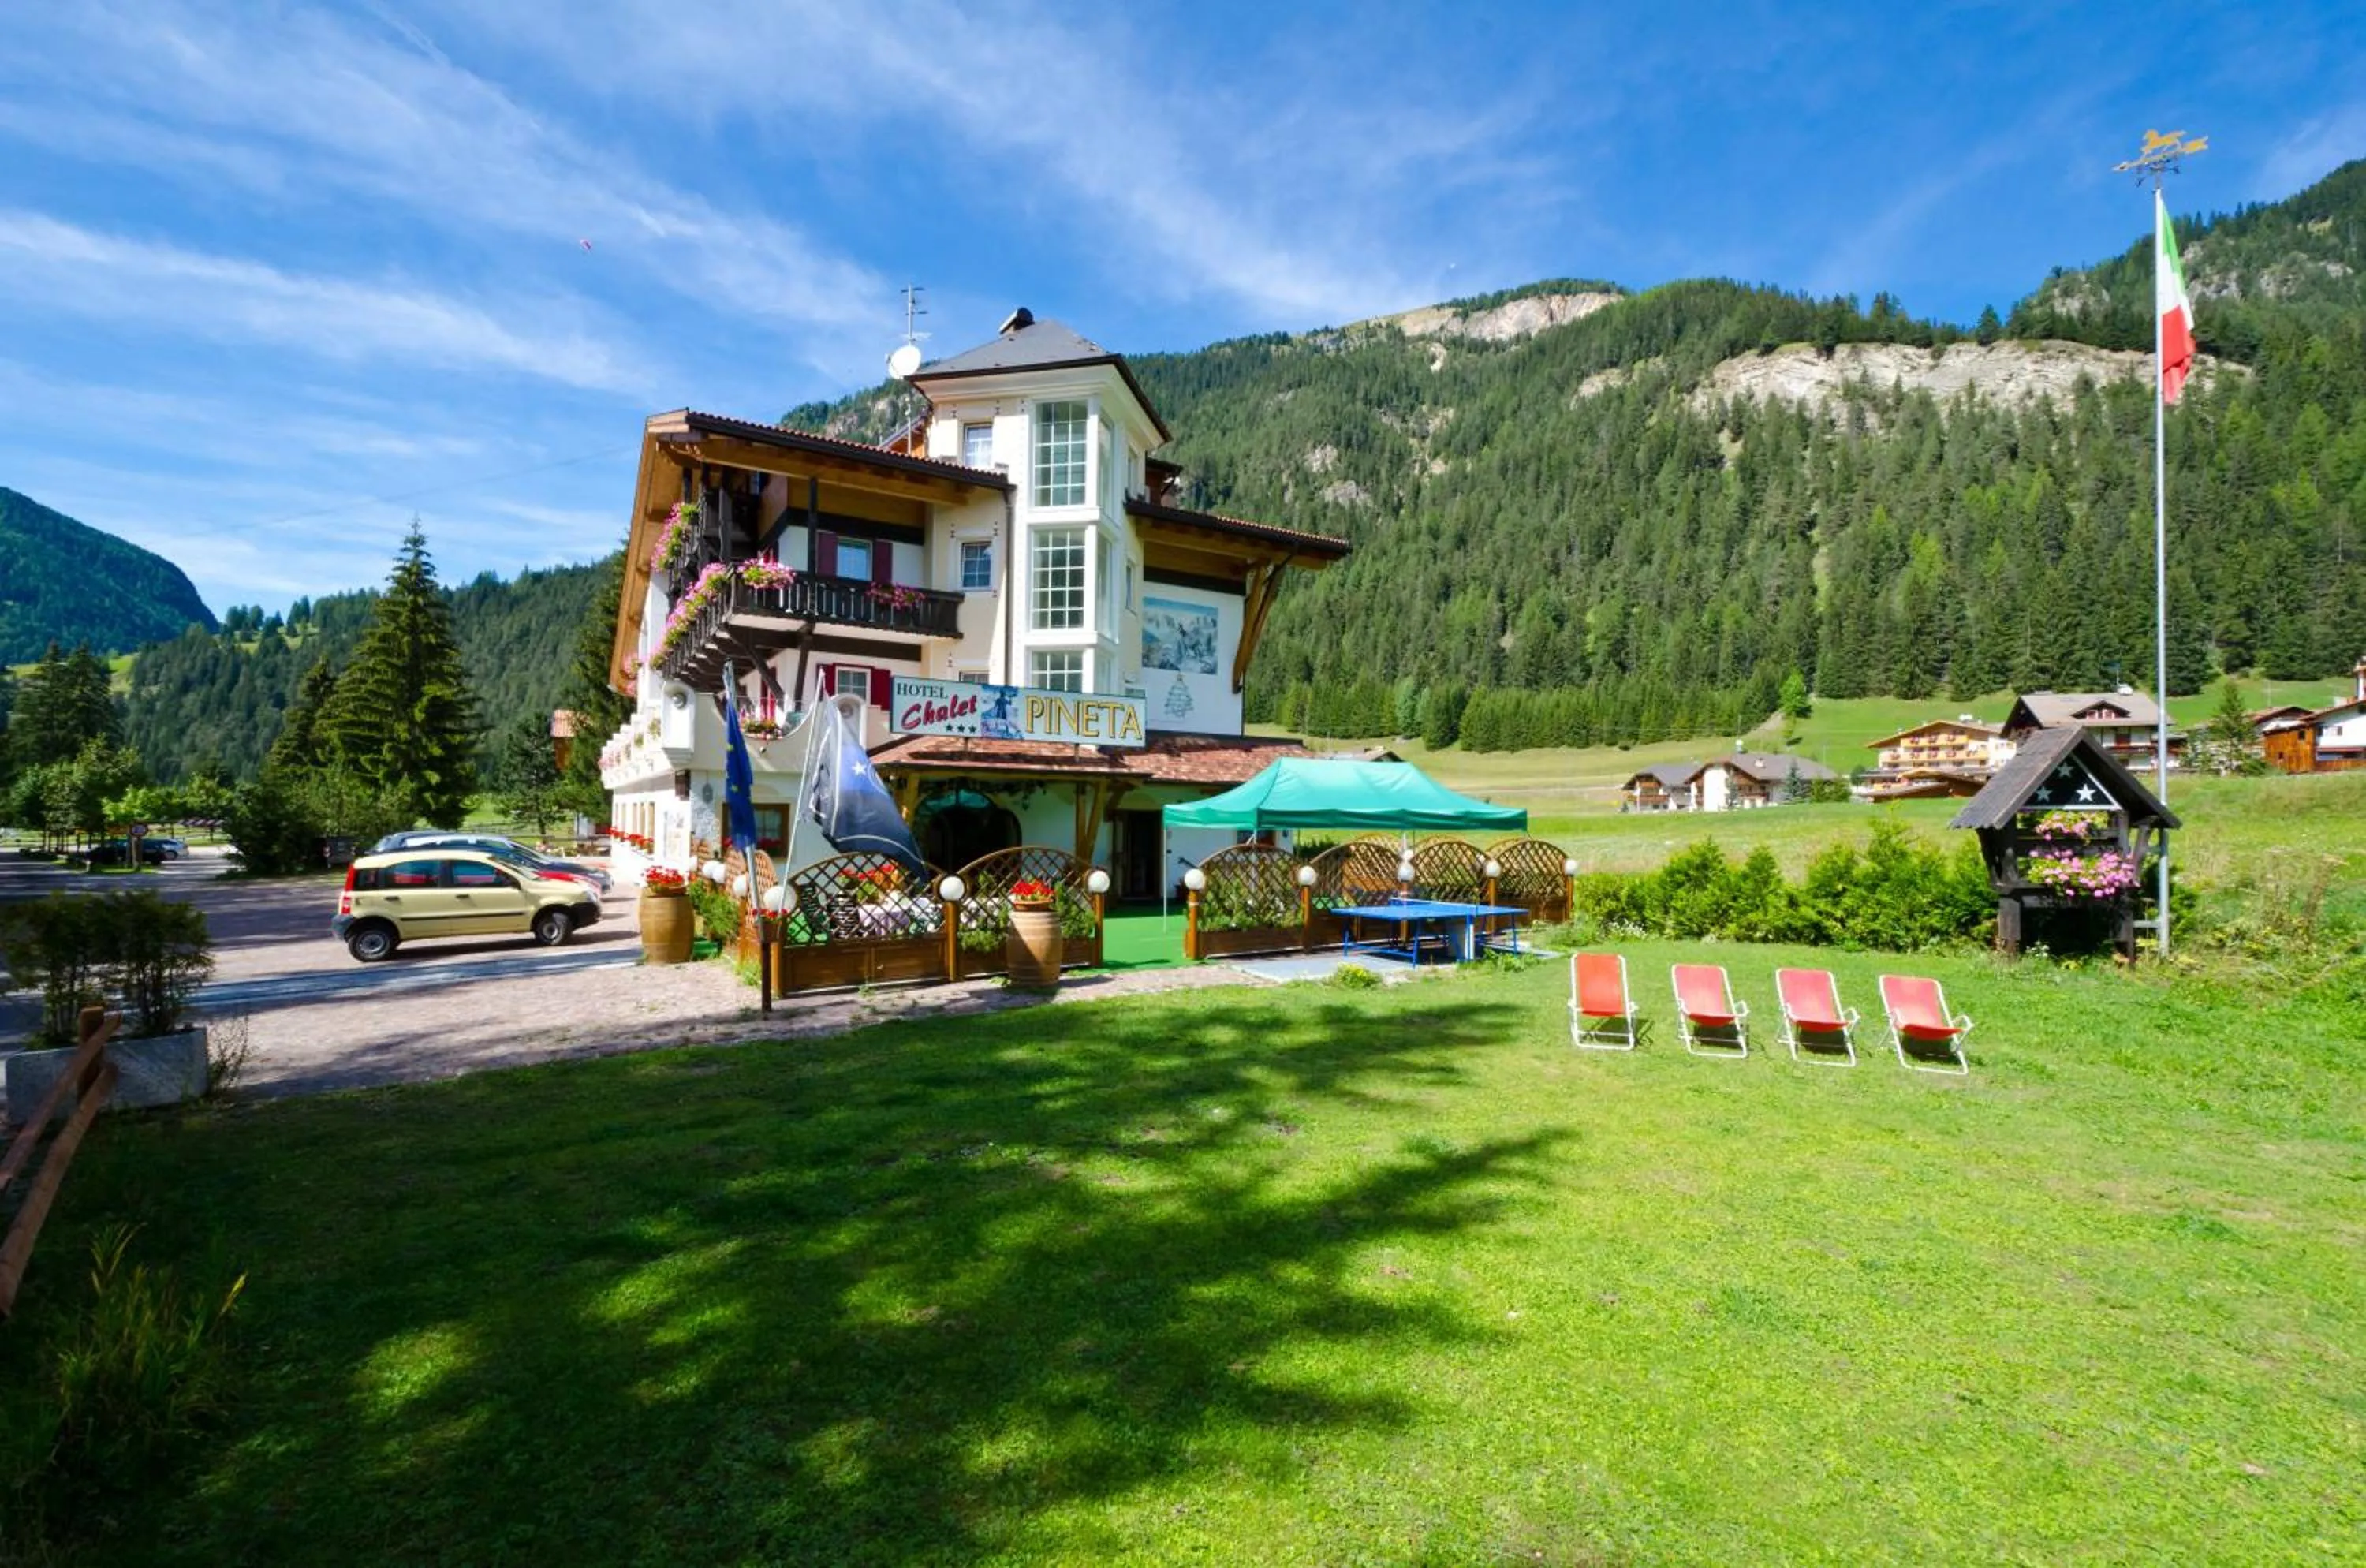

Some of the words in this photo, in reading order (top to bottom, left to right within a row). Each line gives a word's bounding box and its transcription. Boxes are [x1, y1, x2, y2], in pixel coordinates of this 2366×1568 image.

[897, 683, 948, 699] HOTEL
[901, 694, 977, 730] Chalet
[1026, 695, 1143, 740] PINETA
